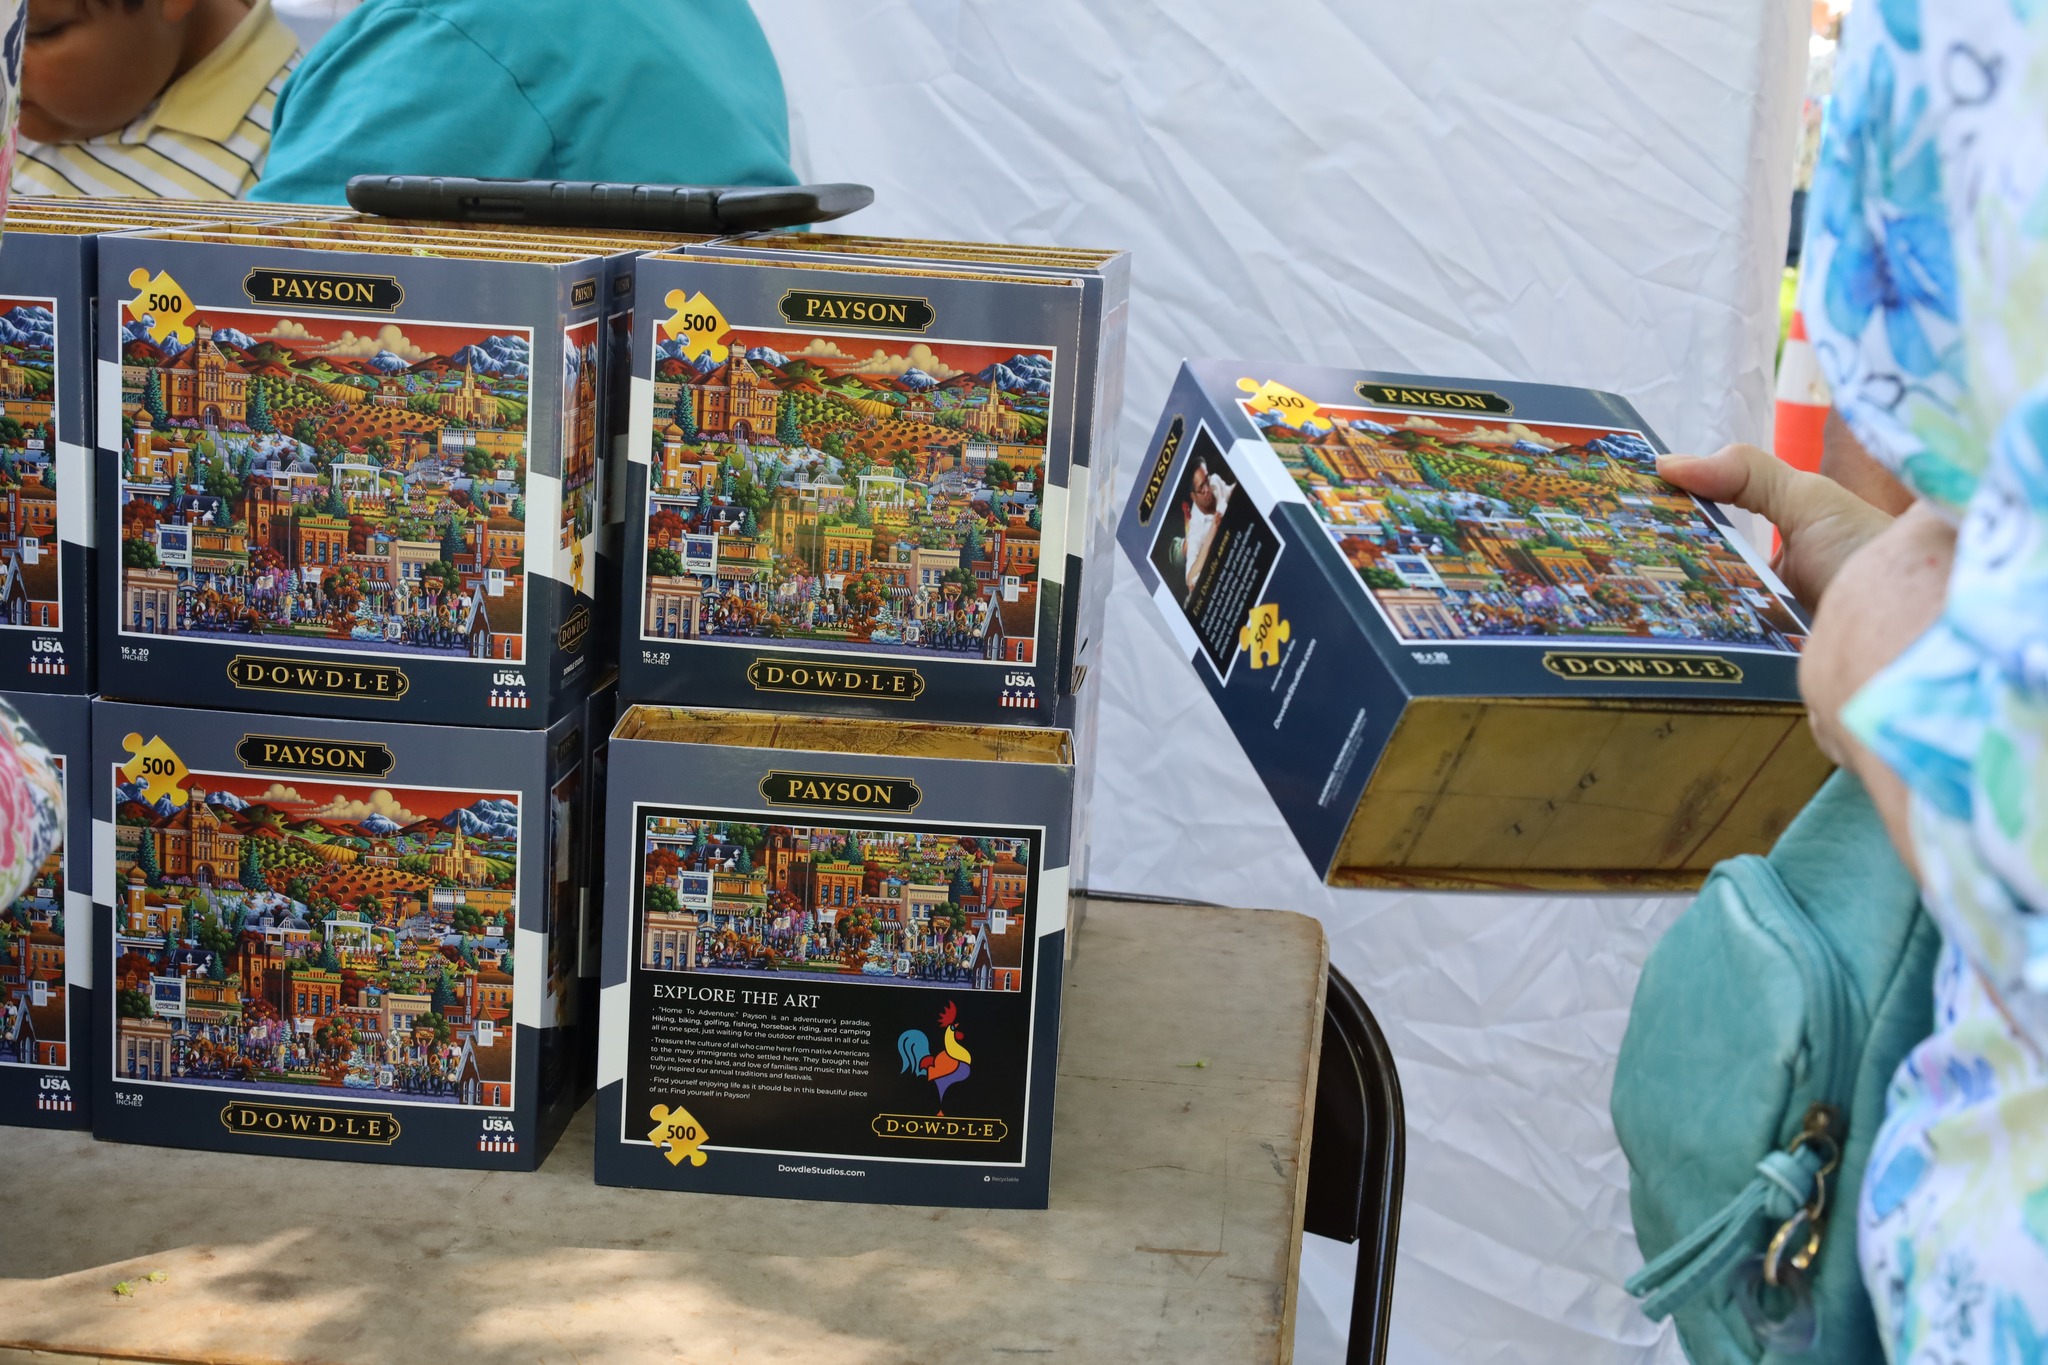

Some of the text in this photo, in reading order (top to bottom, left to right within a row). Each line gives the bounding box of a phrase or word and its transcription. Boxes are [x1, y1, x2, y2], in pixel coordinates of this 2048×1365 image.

[271, 278, 375, 303] PAYSON
[575, 286, 593, 302] PAYSON
[148, 293, 182, 313] 500
[806, 299, 908, 323] PAYSON
[683, 313, 717, 332] 500
[1267, 395, 1304, 409] 500
[1381, 388, 1487, 410] PAYSON
[1145, 432, 1179, 509] PAYSON
[1254, 613, 1273, 650] 500
[32, 640, 64, 653] USA
[120, 646, 130, 654] 16
[138, 648, 150, 656] 20
[122, 654, 148, 662] INCHES
[660, 652, 670, 660] 20
[493, 673, 526, 686] USA
[1005, 675, 1036, 688] USA
[263, 743, 366, 769] PAYSON
[142, 757, 175, 776] 500
[788, 780, 893, 804] PAYSON
[652, 983, 820, 1008] EXPLORE THE ART
[685, 1007, 695, 1015] To
[741, 1011, 767, 1020] Payson
[700, 1026, 715, 1035] just
[715, 1028, 742, 1037] waiting
[743, 1029, 753, 1037] for
[754, 1030, 766, 1038] the
[767, 1032, 795, 1040] outdoor
[796, 1033, 833, 1042] enthusiast
[834, 1035, 841, 1043] in
[851, 1036, 860, 1044] of
[760, 1021, 797, 1031] horseback
[823, 1026, 837, 1034] and
[839, 1028, 871, 1037] camping
[653, 1036, 684, 1045] Treasure
[684, 1038, 696, 1046] the
[696, 1039, 722, 1048] culture
[729, 1041, 739, 1049] all
[738, 1042, 755, 1050] who
[775, 1044, 792, 1052] here
[792, 1045, 810, 1053] from
[810, 1047, 832, 1055] native
[832, 1048, 870, 1057] Americans
[659, 1045, 672, 1053] the
[674, 1047, 695, 1056] many
[696, 1048, 737, 1058] immigrants
[738, 1051, 755, 1059] who
[756, 1053, 781, 1061] settled
[802, 1055, 820, 1065] They
[821, 1056, 850, 1066] brought
[852, 1058, 869, 1066] their
[649, 1063, 666, 1072] truly
[666, 1064, 695, 1073] inspired
[734, 1069, 768, 1078] traditions
[768, 1071, 783, 1079] and
[677, 1055, 692, 1064] love
[692, 1056, 700, 1064] of
[700, 1057, 713, 1065] the
[731, 1060, 746, 1068] and
[746, 1060, 761, 1068] love
[762, 1061, 770, 1069] of
[770, 1062, 798, 1071] families
[798, 1064, 813, 1072] and
[835, 1066, 851, 1074] that
[851, 1067, 869, 1075] have
[40, 1078, 71, 1090] USA
[653, 1075, 669, 1084] Find
[669, 1078, 698, 1086] yourself
[698, 1079, 729, 1089] enjoying
[729, 1081, 741, 1089] life
[751, 1082, 756, 1090] it
[757, 1083, 782, 1092] should
[782, 1084, 792, 1092] be
[793, 1085, 801, 1093] in
[801, 1086, 815, 1094] this
[816, 1087, 847, 1096] beautiful
[848, 1089, 868, 1097] piece
[669, 1086, 686, 1095] Find
[714, 1089, 722, 1097] in
[115, 1092, 124, 1100] 16
[482, 1119, 515, 1132] USA
[666, 1124, 697, 1141] 500
[778, 1164, 866, 1177] DowdleStudios.com
